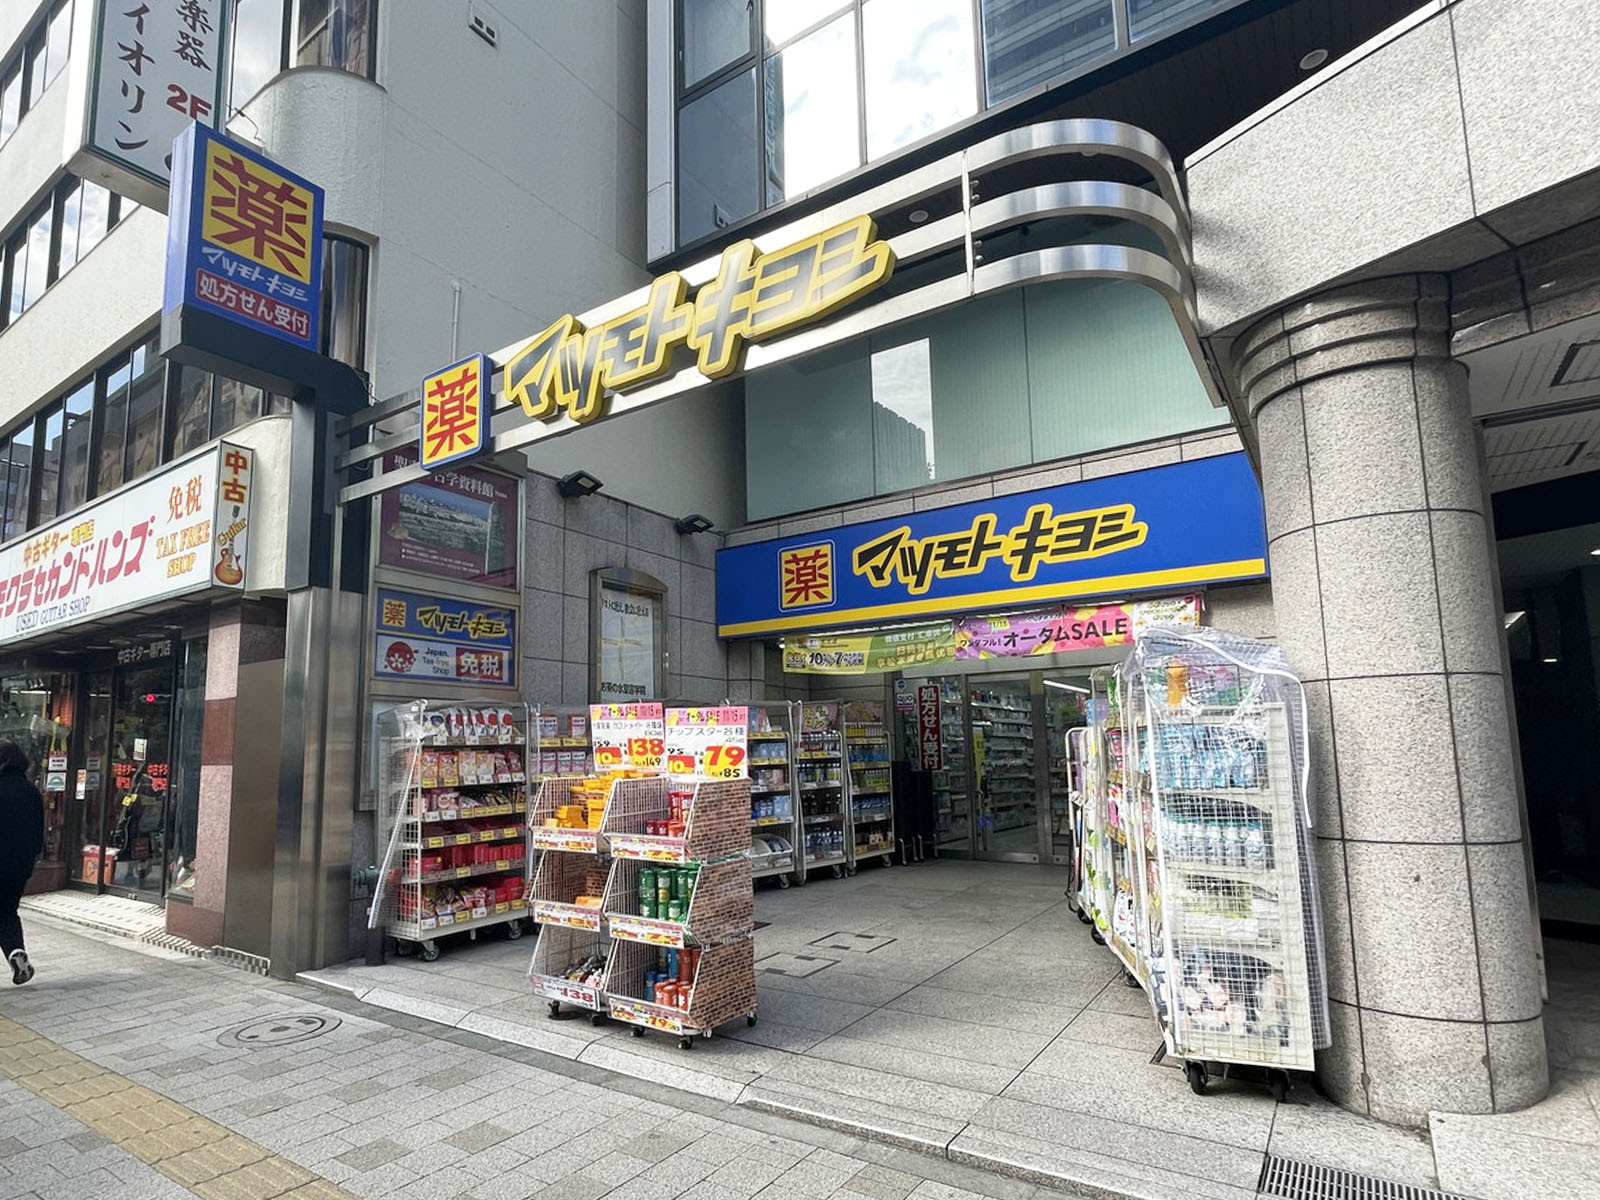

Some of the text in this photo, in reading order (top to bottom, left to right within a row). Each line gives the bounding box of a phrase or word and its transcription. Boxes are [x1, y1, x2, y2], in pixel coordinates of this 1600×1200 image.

[166, 83, 212, 120] 2F
[211, 154, 308, 279] 薬
[201, 246, 310, 303] マツモトキヨシ
[199, 276, 310, 337] 処方せん受付
[426, 214, 896, 458] 薬 マツモトキヨシ
[167, 475, 202, 524] 免税
[222, 450, 248, 505] 中古
[156, 520, 211, 560] TAX FREE
[784, 503, 1149, 605] 薬 マツモトキヨシ
[167, 552, 197, 578] SHOP
[69, 595, 91, 617] SHOP
[384, 600, 507, 639] 薬 マツモトキヨシ
[460, 652, 500, 678] 免税
[921, 687, 940, 770] 処方せん受付
[705, 746, 745, 767] 79
